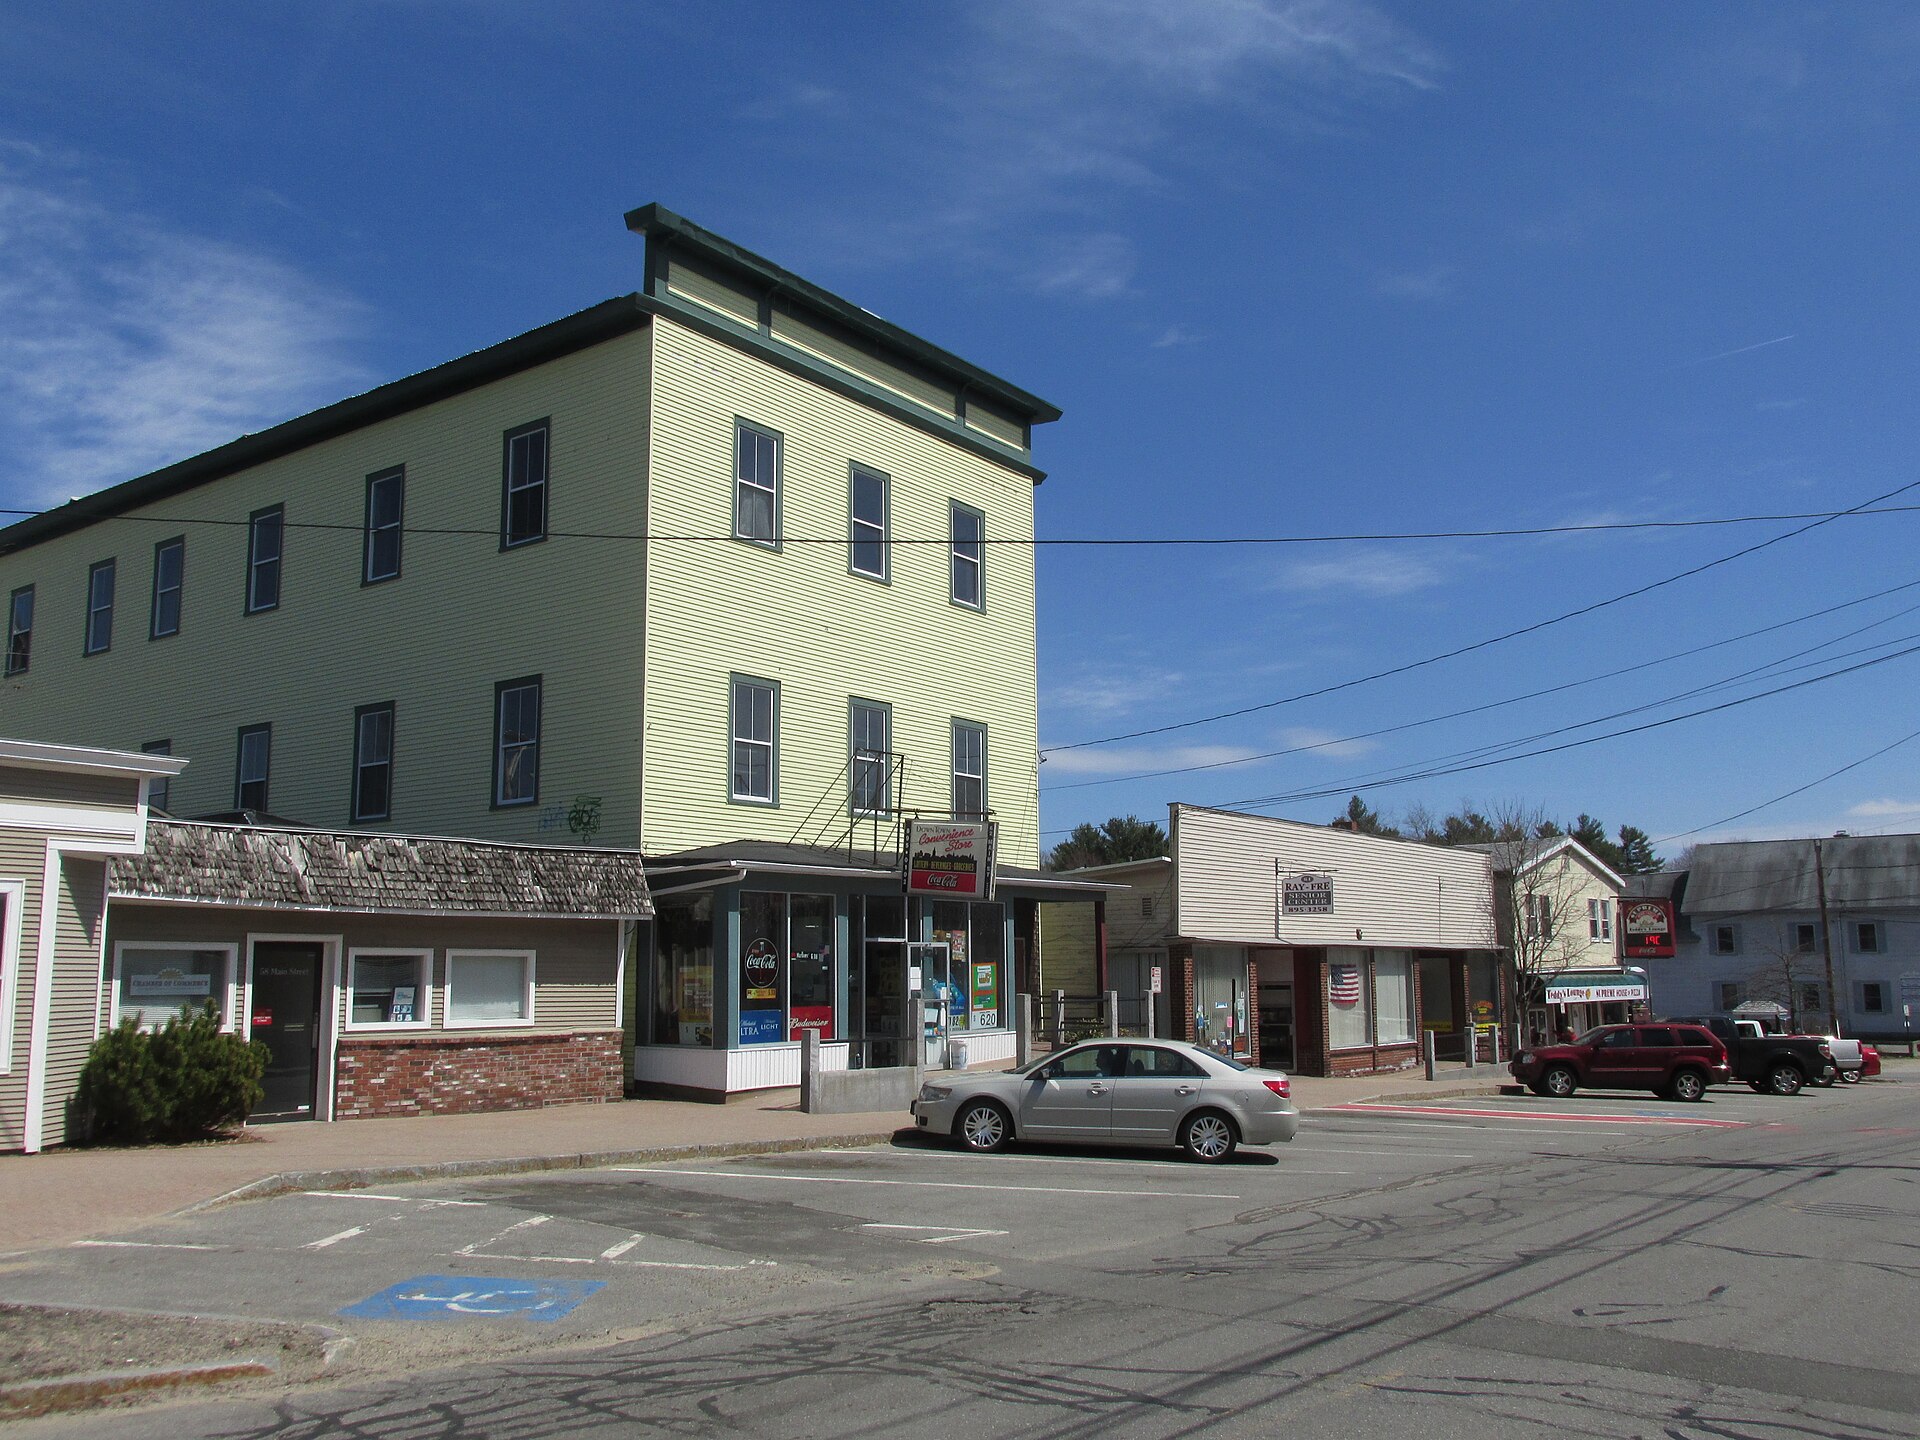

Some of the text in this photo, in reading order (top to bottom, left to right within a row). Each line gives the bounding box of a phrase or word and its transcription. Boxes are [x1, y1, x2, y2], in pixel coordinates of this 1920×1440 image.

[919, 828, 975, 845] Convenience
[945, 839, 973, 852] Store
[790, 1017, 829, 1029] Budweiser
[980, 1013, 996, 1026] 620
[740, 1027, 759, 1036] LTRA
